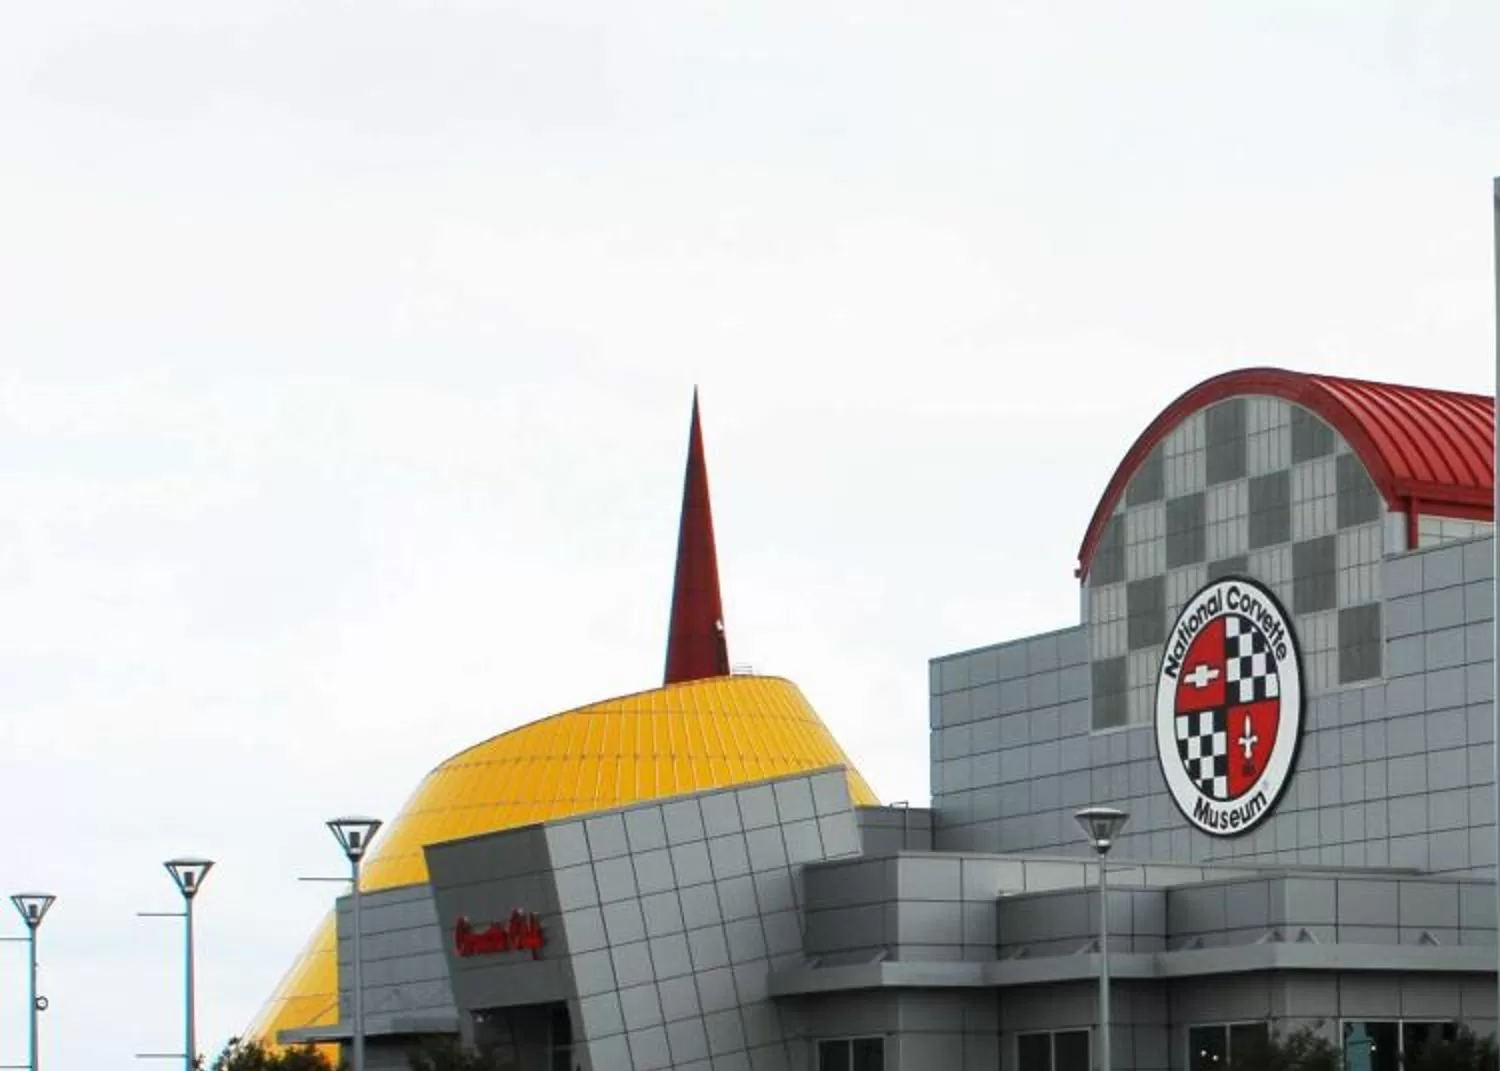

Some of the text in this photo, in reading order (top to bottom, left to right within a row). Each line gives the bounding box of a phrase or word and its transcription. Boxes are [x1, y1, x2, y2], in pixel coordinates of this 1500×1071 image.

[1164, 586, 1287, 679] National Corvette
[1193, 791, 1267, 830] Museum
